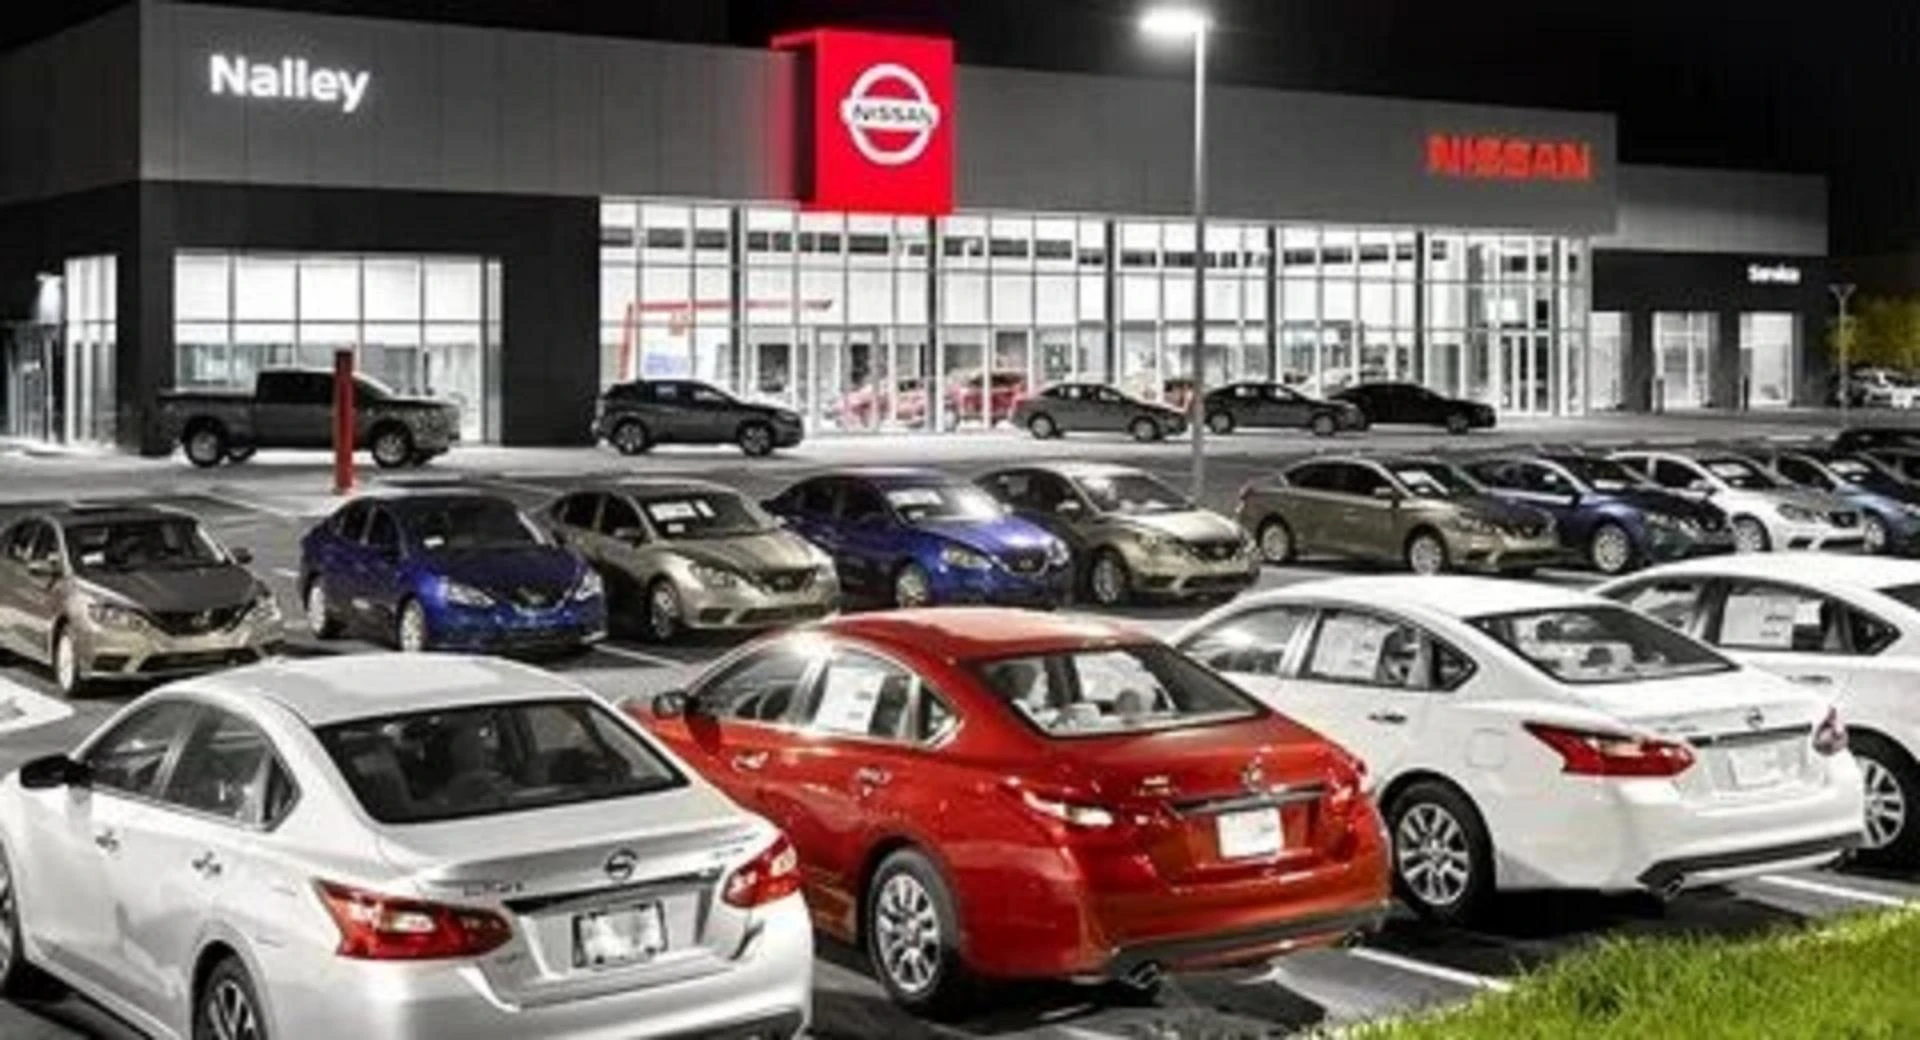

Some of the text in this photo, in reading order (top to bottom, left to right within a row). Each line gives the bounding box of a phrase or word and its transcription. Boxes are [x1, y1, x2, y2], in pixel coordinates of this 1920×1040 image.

[210, 54, 370, 114] Nalley
[853, 103, 933, 125] NISSAN
[1427, 133, 1592, 181] NISSAN
[1747, 263, 1801, 285] Service
